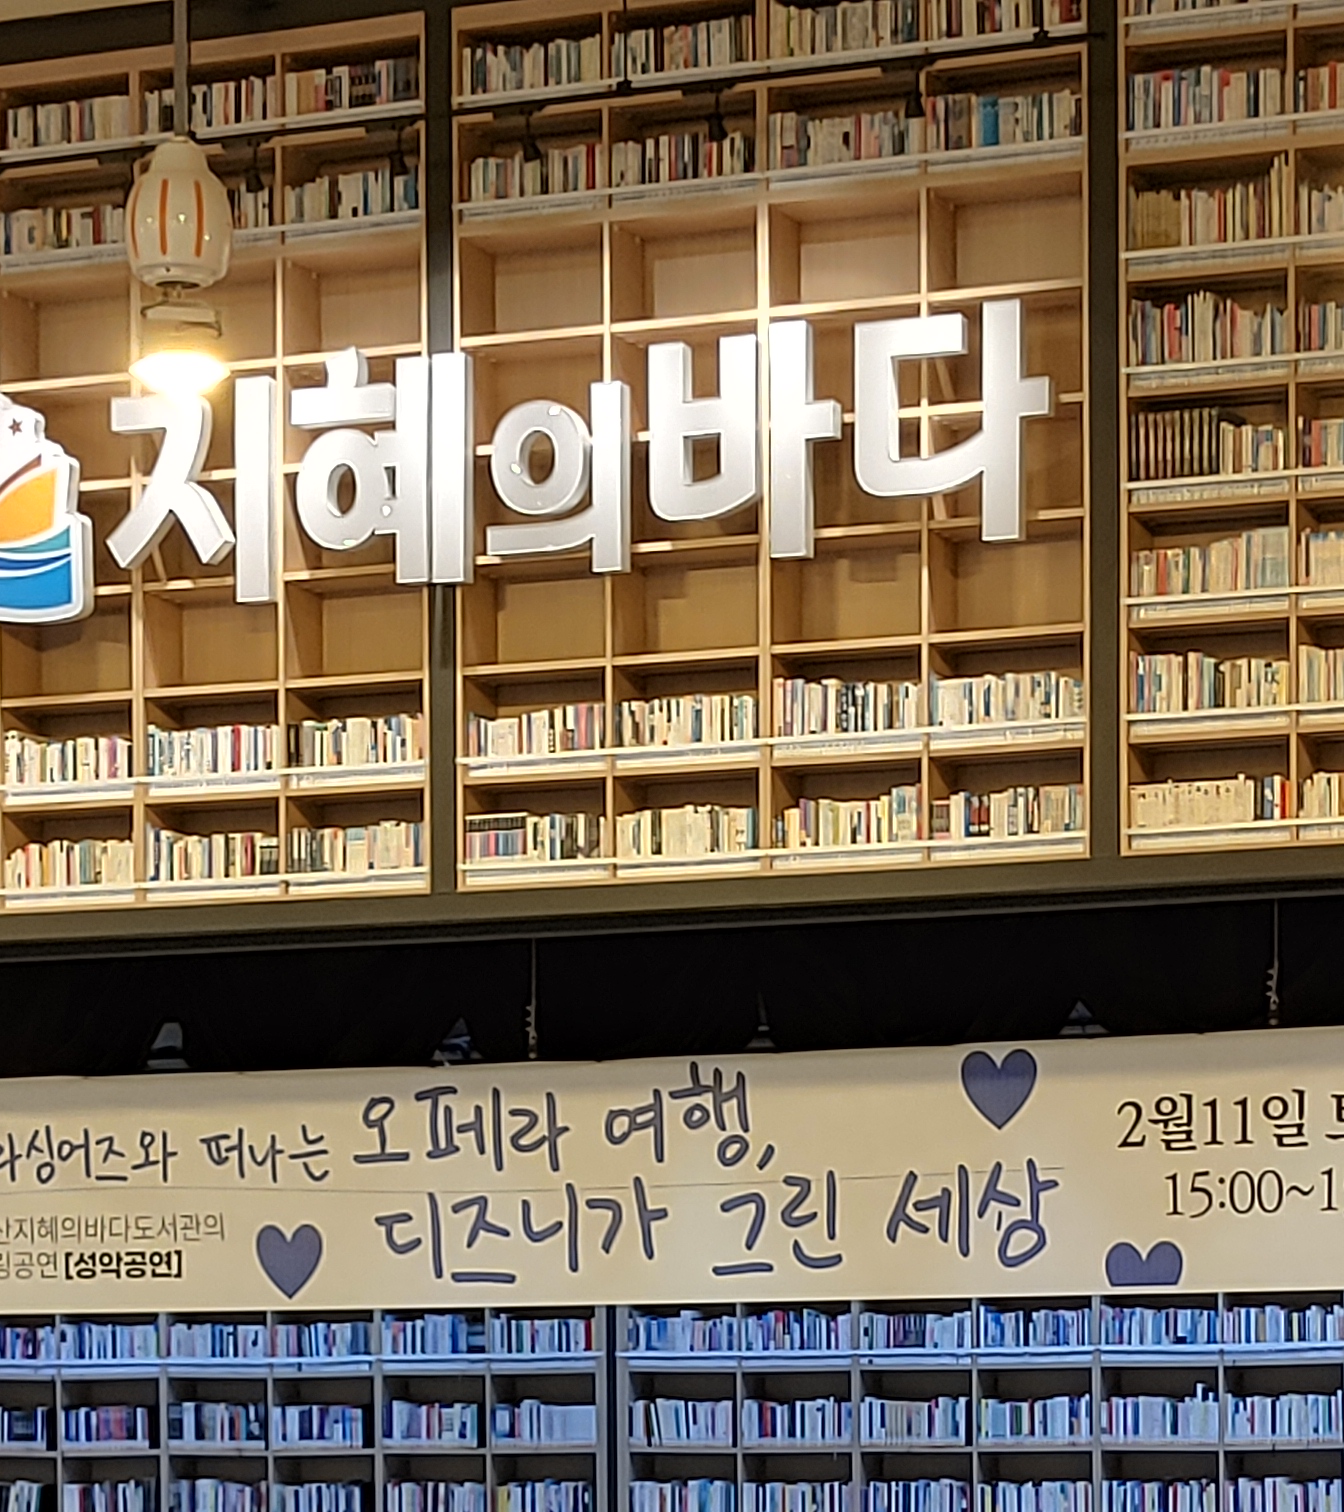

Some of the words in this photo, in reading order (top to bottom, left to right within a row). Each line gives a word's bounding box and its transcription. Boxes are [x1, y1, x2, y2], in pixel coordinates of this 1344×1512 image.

[107, 297, 1054, 604] 지혜의바다
[199, 1123, 330, 1184] 떠나는
[352, 1086, 571, 1173] 오페라
[604, 1061, 775, 1170] 여행,
[1116, 1088, 1309, 1152] 2월11일
[63, 1249, 183, 1281] [성악공연]
[374, 1176, 669, 1284] 디즈니가
[711, 1170, 844, 1276] 그린
[885, 1157, 1060, 1269] 세상
